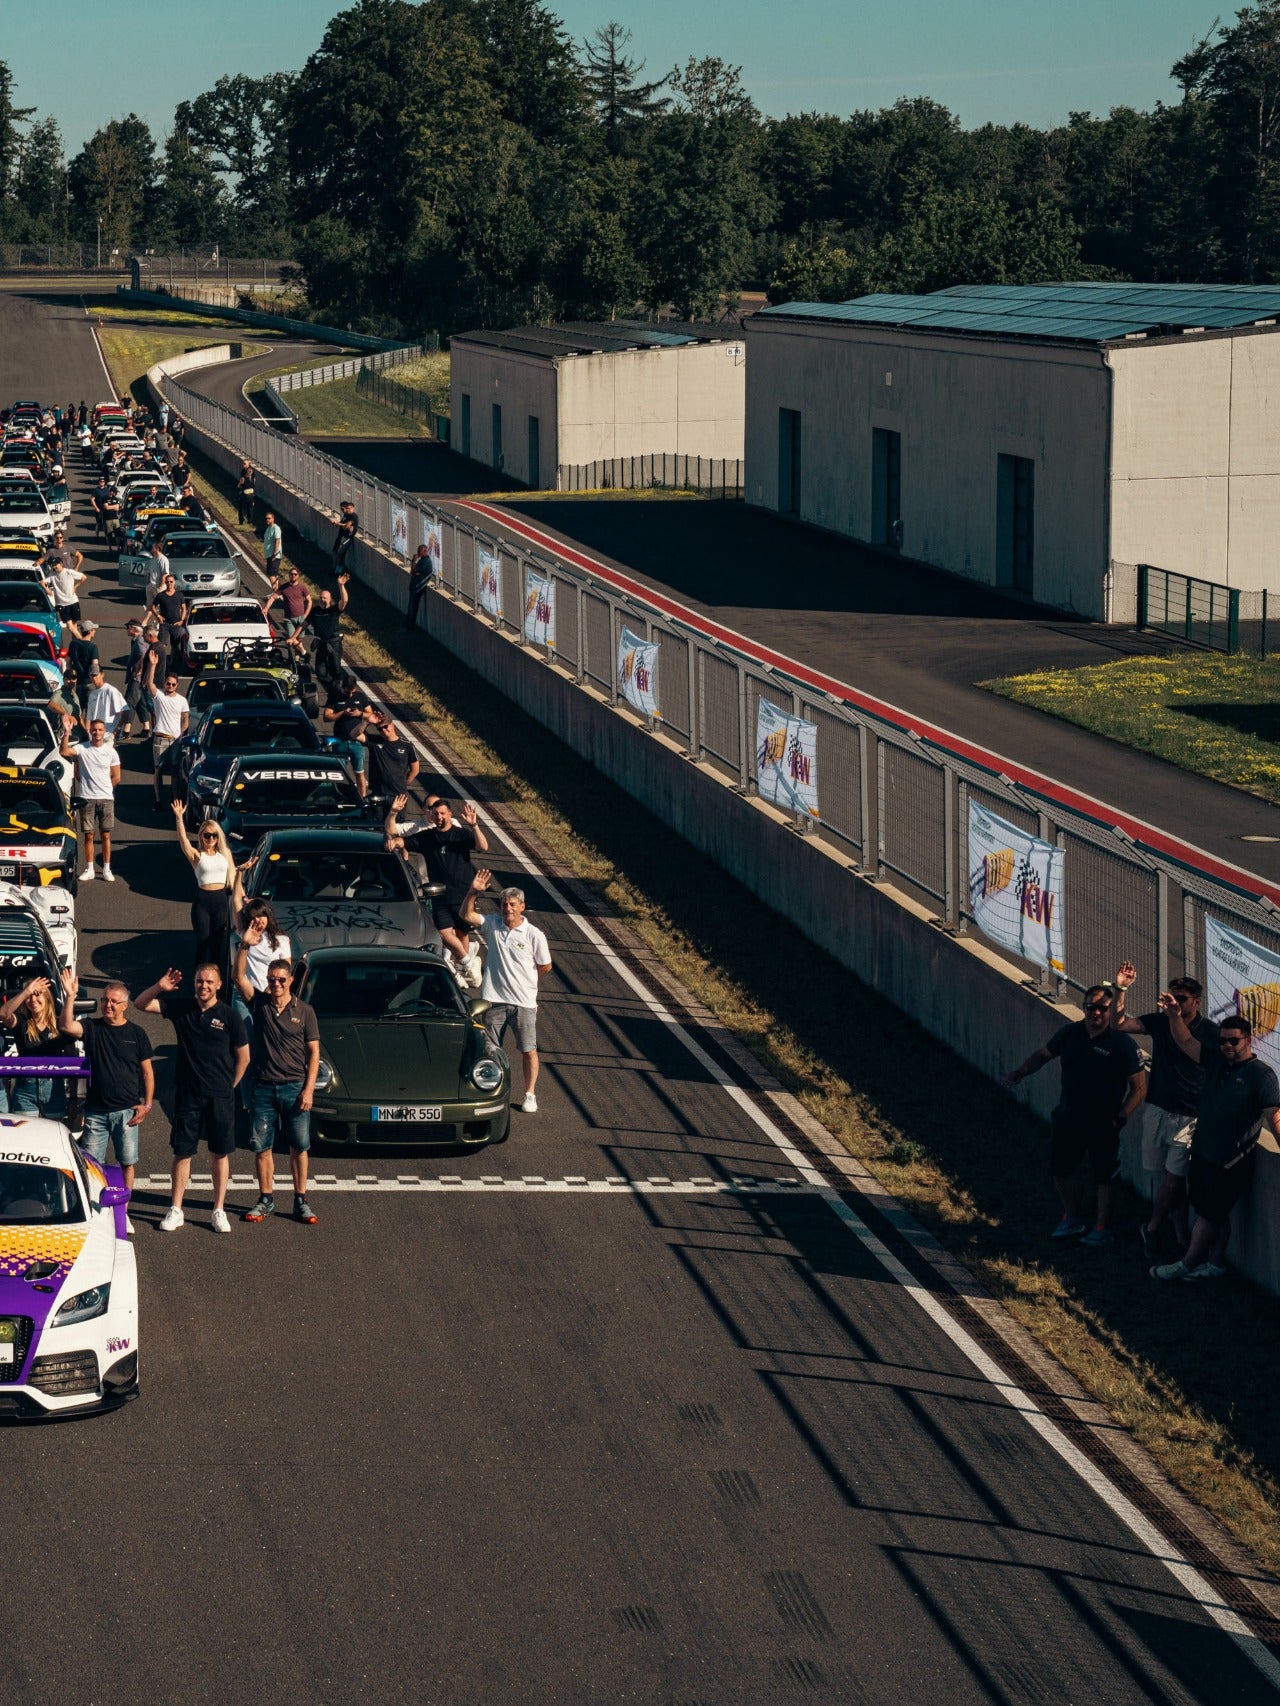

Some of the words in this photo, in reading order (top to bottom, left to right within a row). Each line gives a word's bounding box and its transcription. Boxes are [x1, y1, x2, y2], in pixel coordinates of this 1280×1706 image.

[131, 562, 144, 574] 70
[243, 770, 344, 781] VERSUS
[1020, 878, 1055, 929] KW
[285, 904, 384, 918] BORN
[378, 1108, 394, 1120] MN
[419, 1108, 441, 1120] 550
